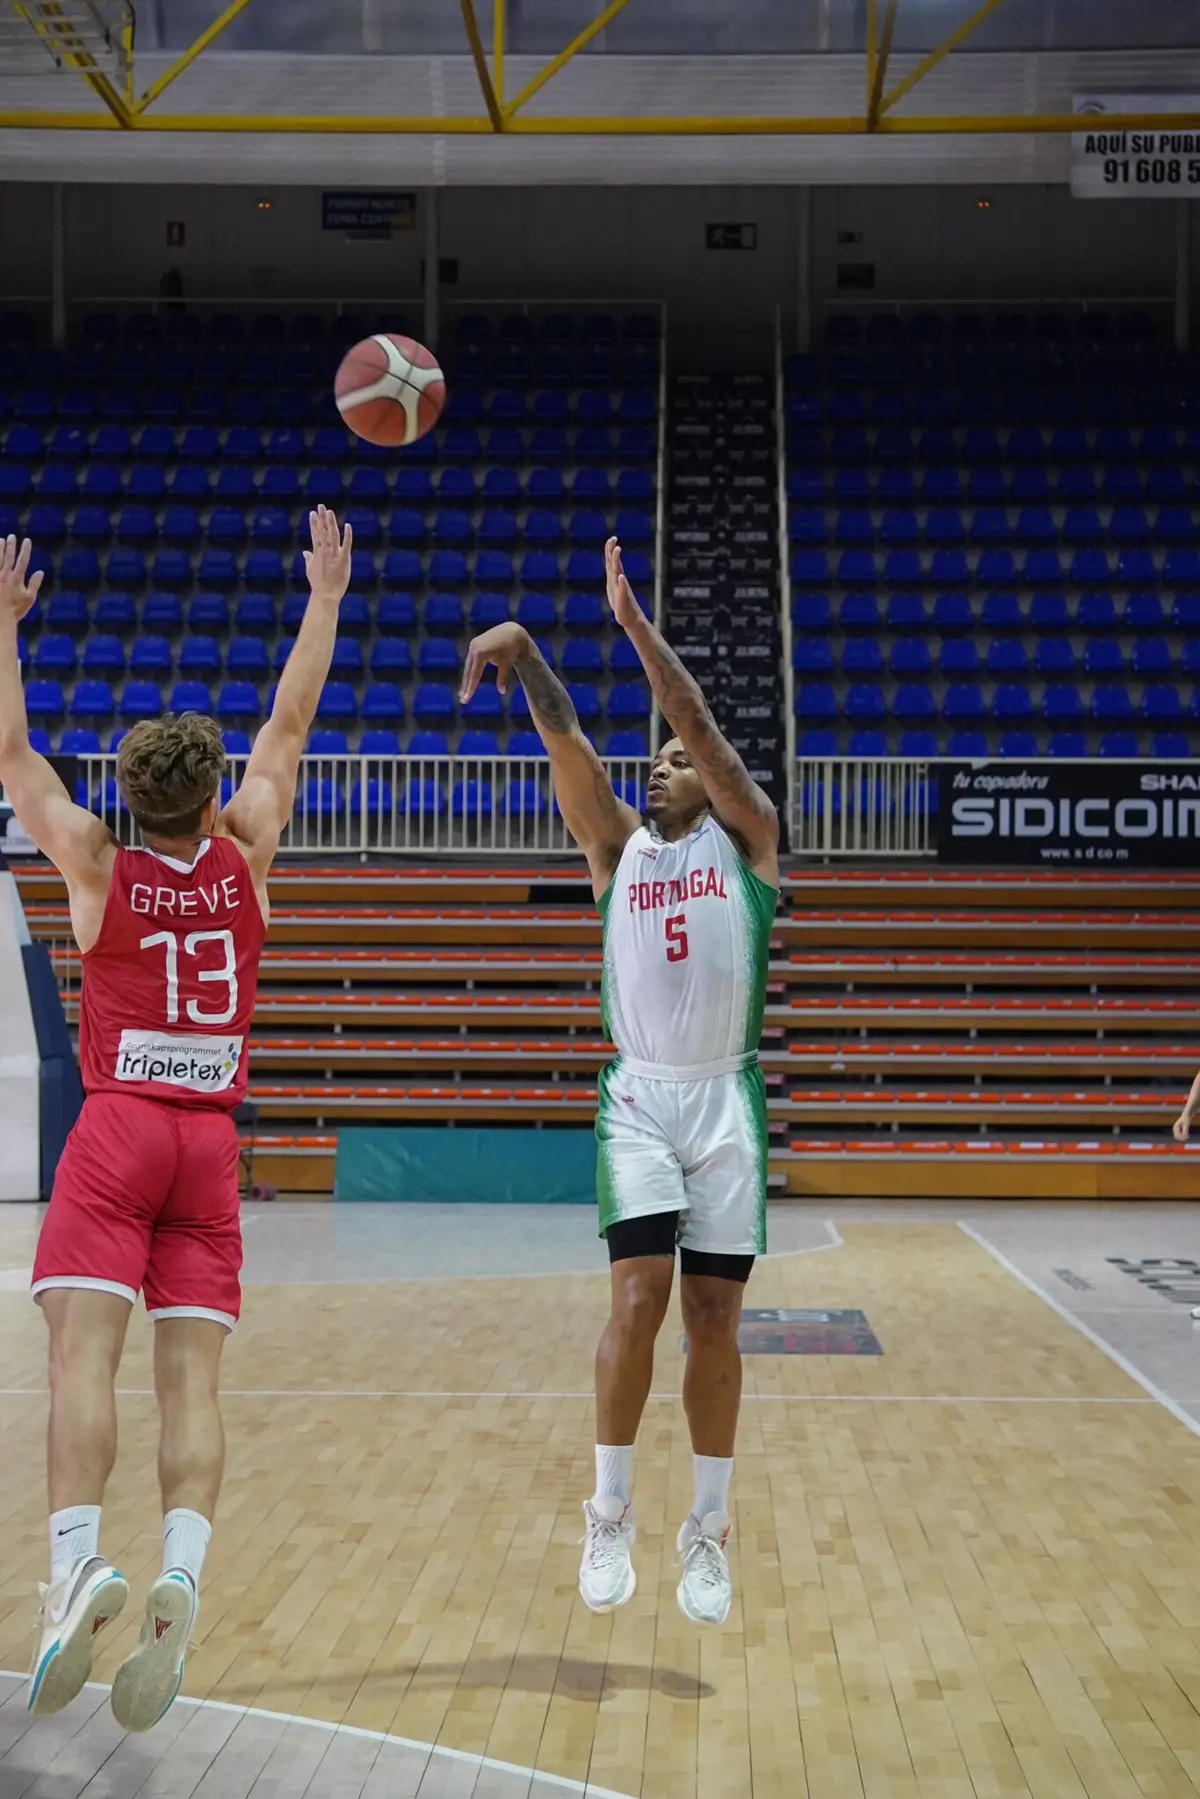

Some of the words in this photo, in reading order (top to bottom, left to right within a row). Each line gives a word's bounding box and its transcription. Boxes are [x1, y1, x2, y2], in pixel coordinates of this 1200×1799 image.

[1085, 130, 1127, 155] AQUÍ
[1131, 134, 1155, 154] SU
[1103, 158, 1130, 184] 91
[1135, 158, 1182, 184] 608
[952, 771, 971, 789] tu
[1140, 773, 1200, 791] SHA
[130, 874, 240, 916] GREVE
[628, 866, 728, 914] PORTUGAL
[664, 913, 689, 963] 5
[139, 929, 239, 1025] 13
[125, 1041, 222, 1056] Regnskapsprogrammet
[122, 1052, 223, 1081] tripletex
